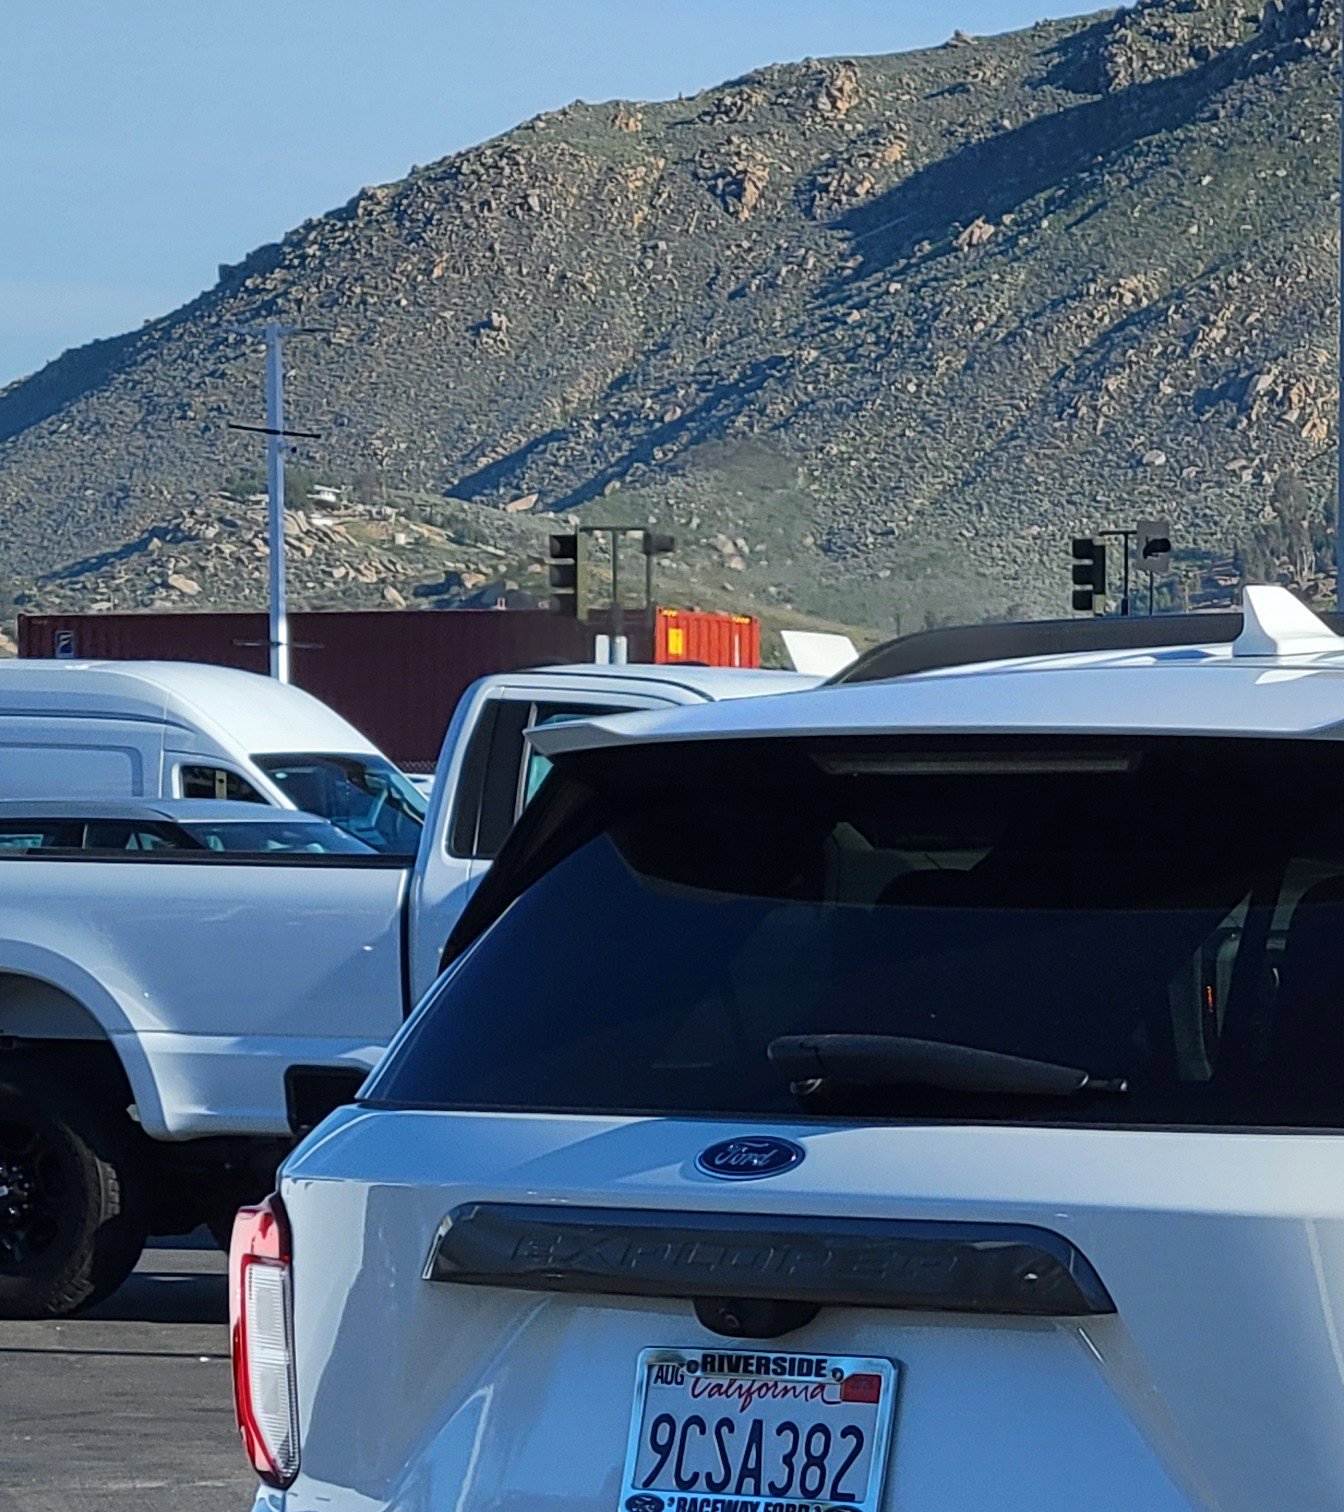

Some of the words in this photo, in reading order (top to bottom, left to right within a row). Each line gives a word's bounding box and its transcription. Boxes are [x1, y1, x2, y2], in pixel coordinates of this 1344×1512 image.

[653, 1364, 685, 1386] AUG
[700, 1353, 828, 1378] RIVERSIDE
[691, 1376, 841, 1413] California
[641, 1413, 864, 1501] 9CSA382
